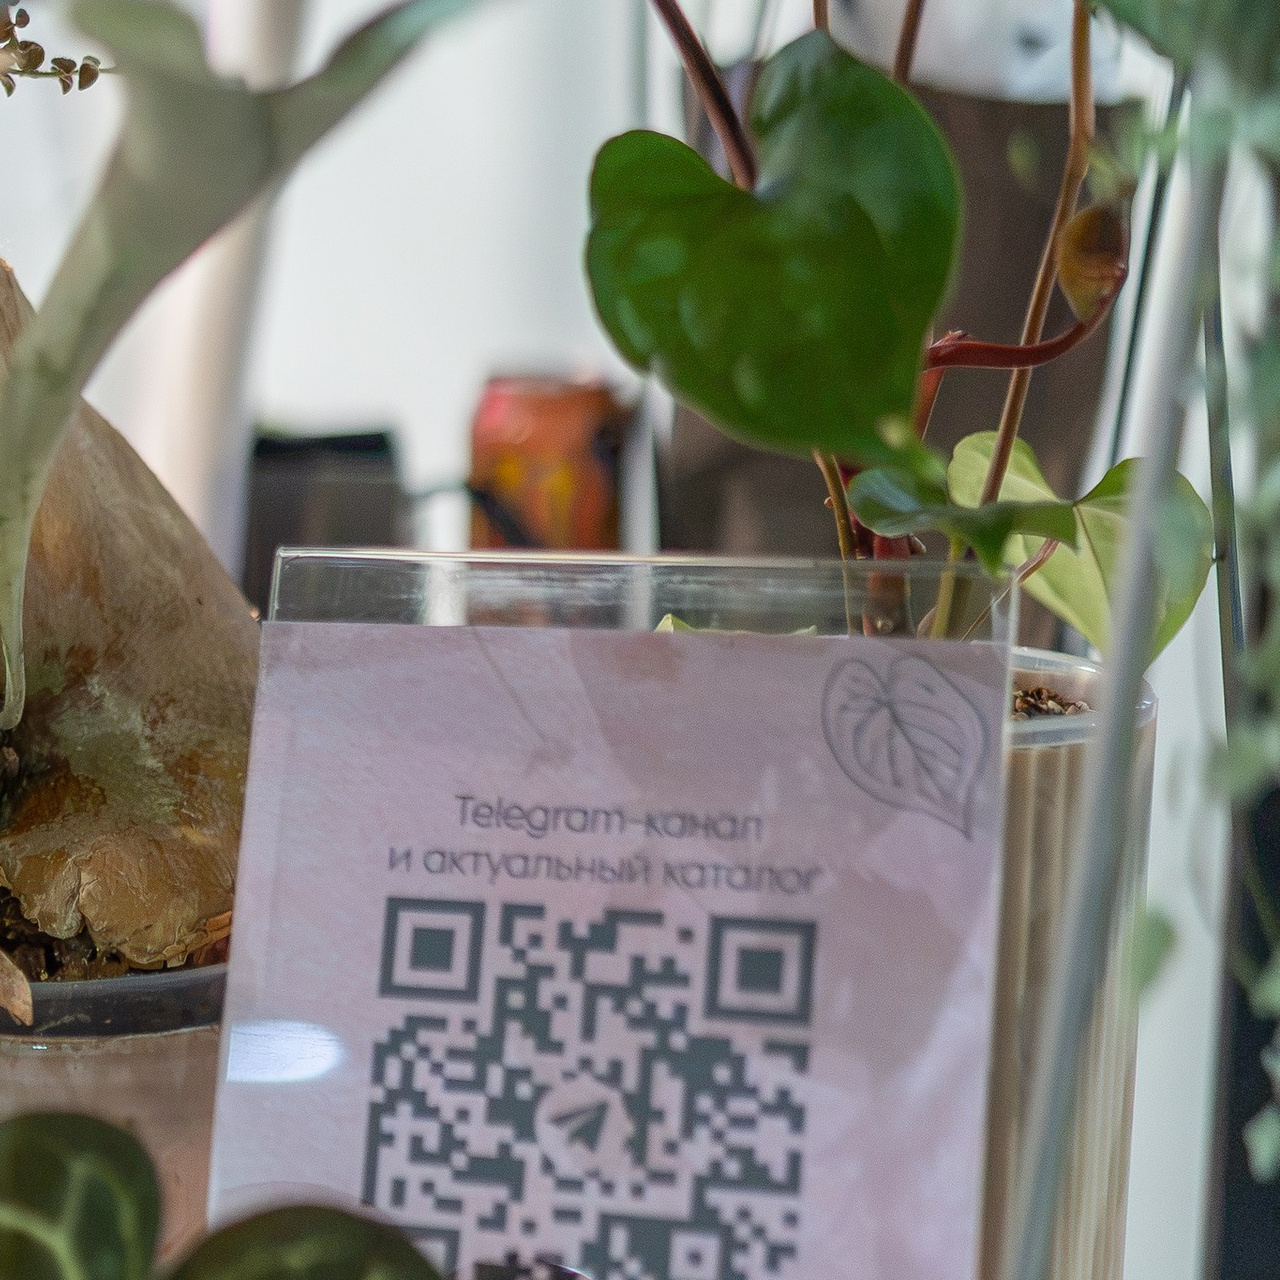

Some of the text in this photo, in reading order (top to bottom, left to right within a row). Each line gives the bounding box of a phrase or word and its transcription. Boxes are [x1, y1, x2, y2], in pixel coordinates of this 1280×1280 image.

[388, 847, 822, 896] и актуальный каталог
